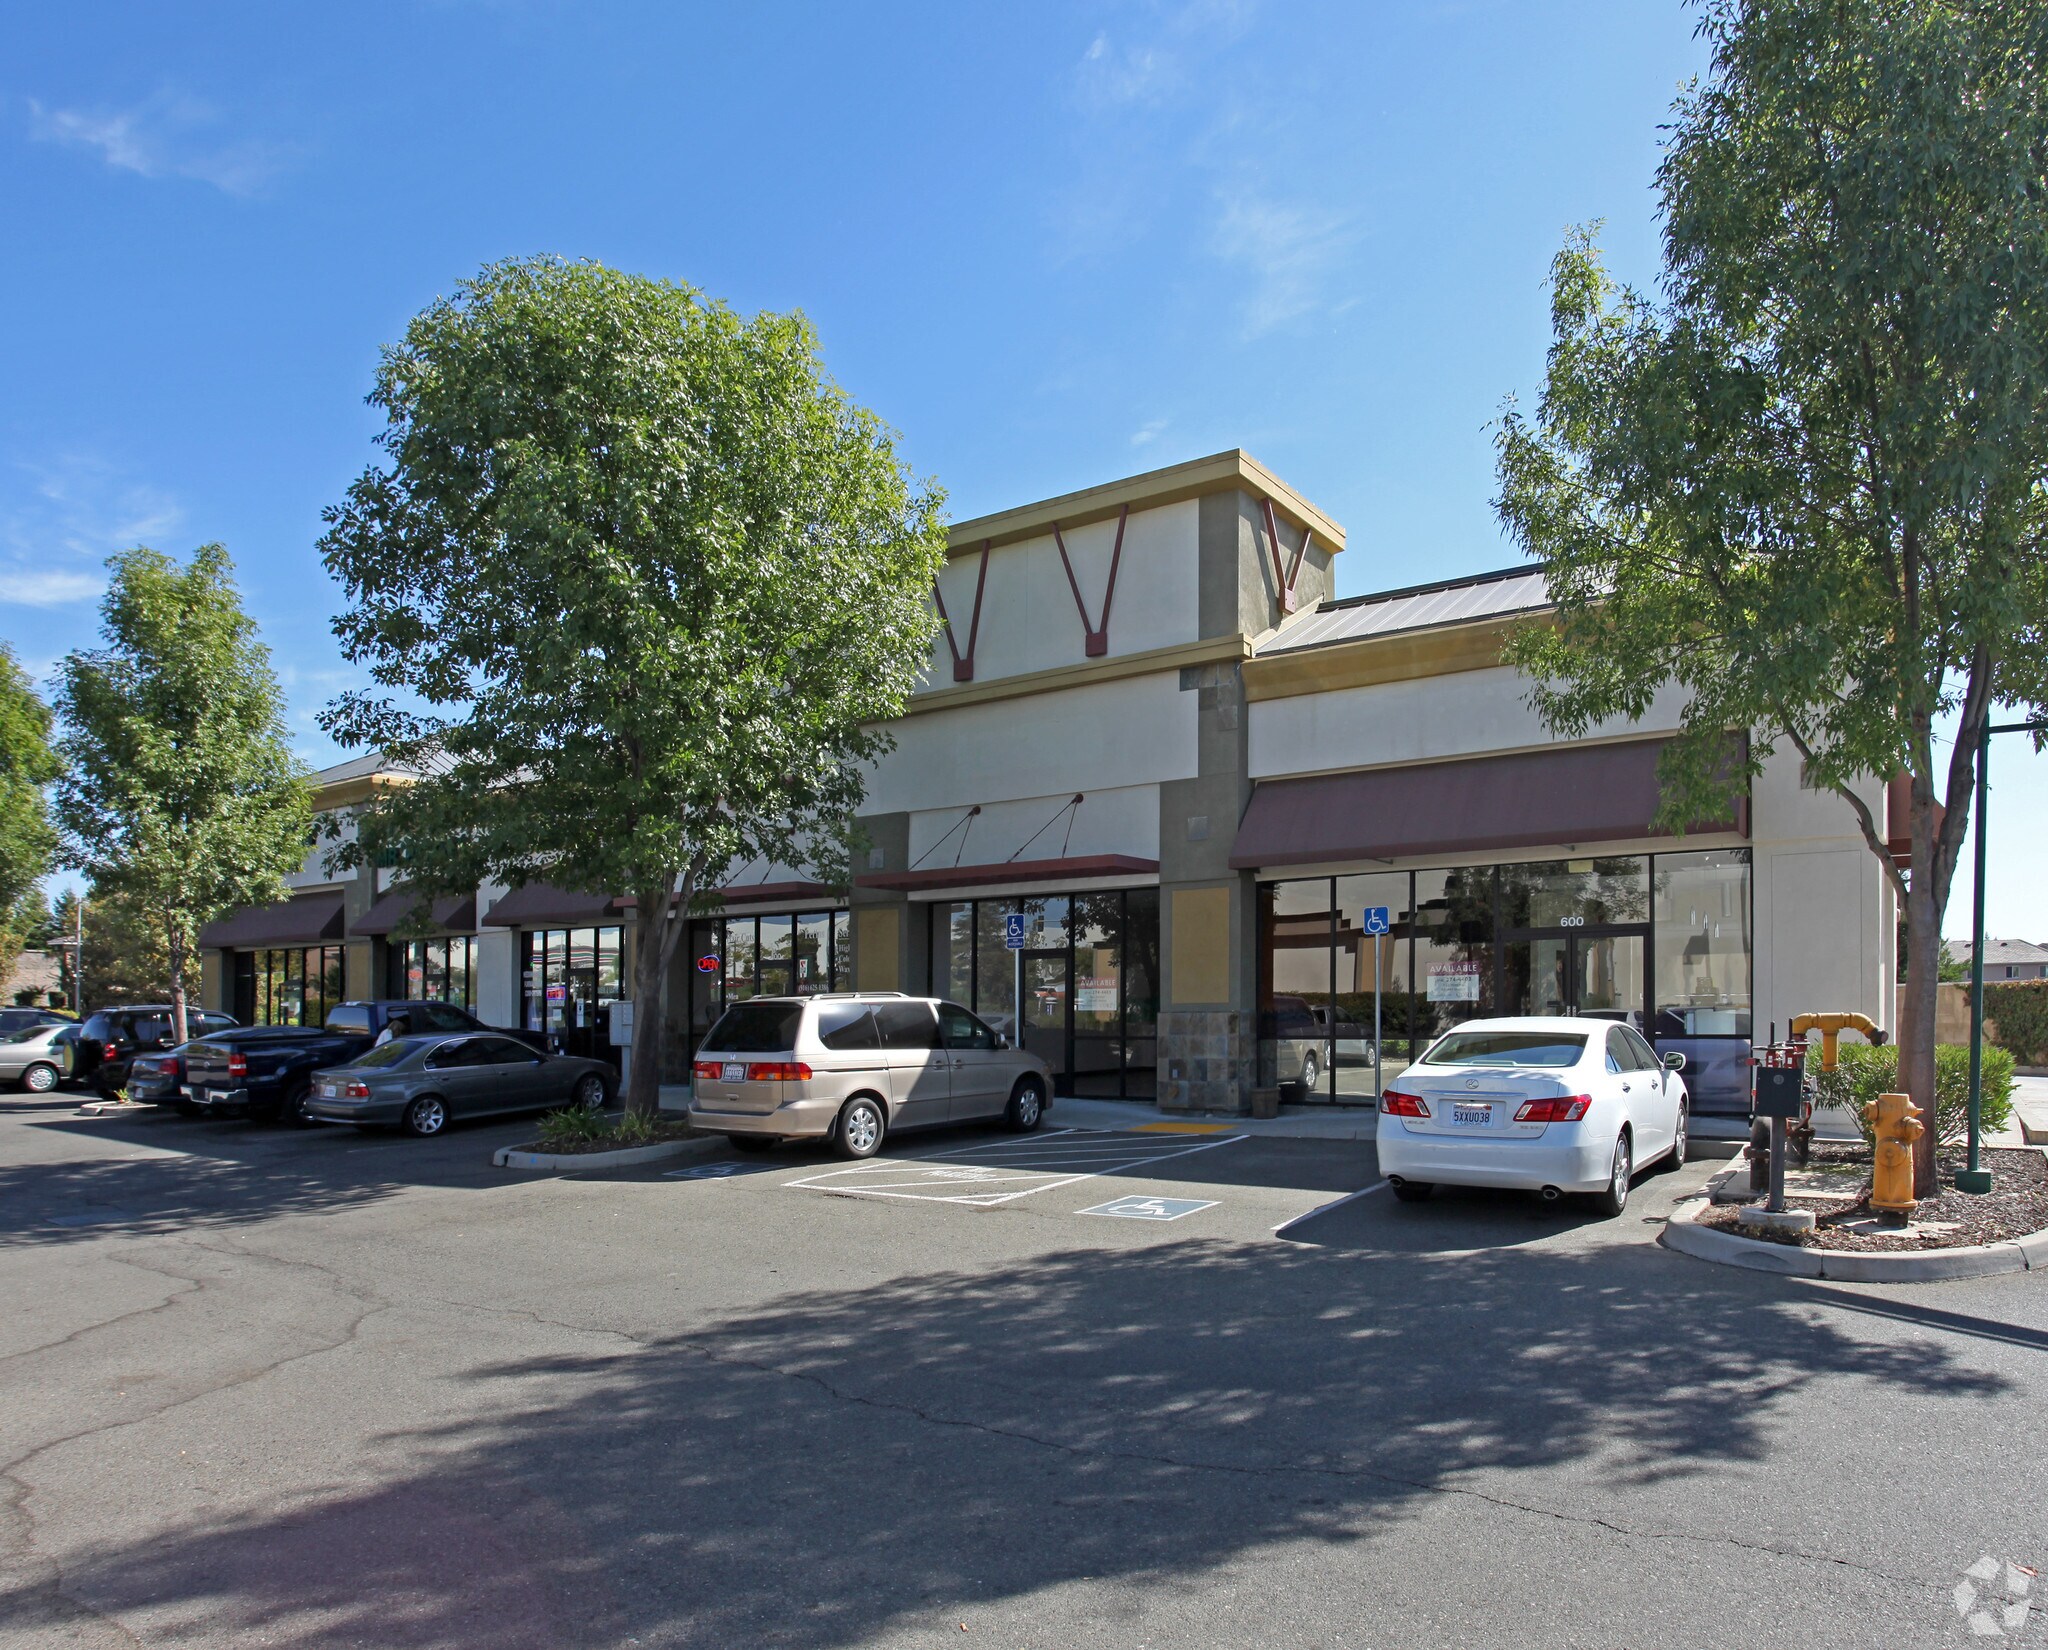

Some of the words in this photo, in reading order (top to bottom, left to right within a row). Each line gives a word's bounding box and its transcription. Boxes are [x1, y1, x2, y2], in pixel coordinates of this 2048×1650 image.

[1560, 916, 1584, 927] 600
[698, 957, 719, 970] OPEN
[1430, 964, 1478, 973] AVAILABLE
[1453, 1111, 1490, 1123] 5XXU038
